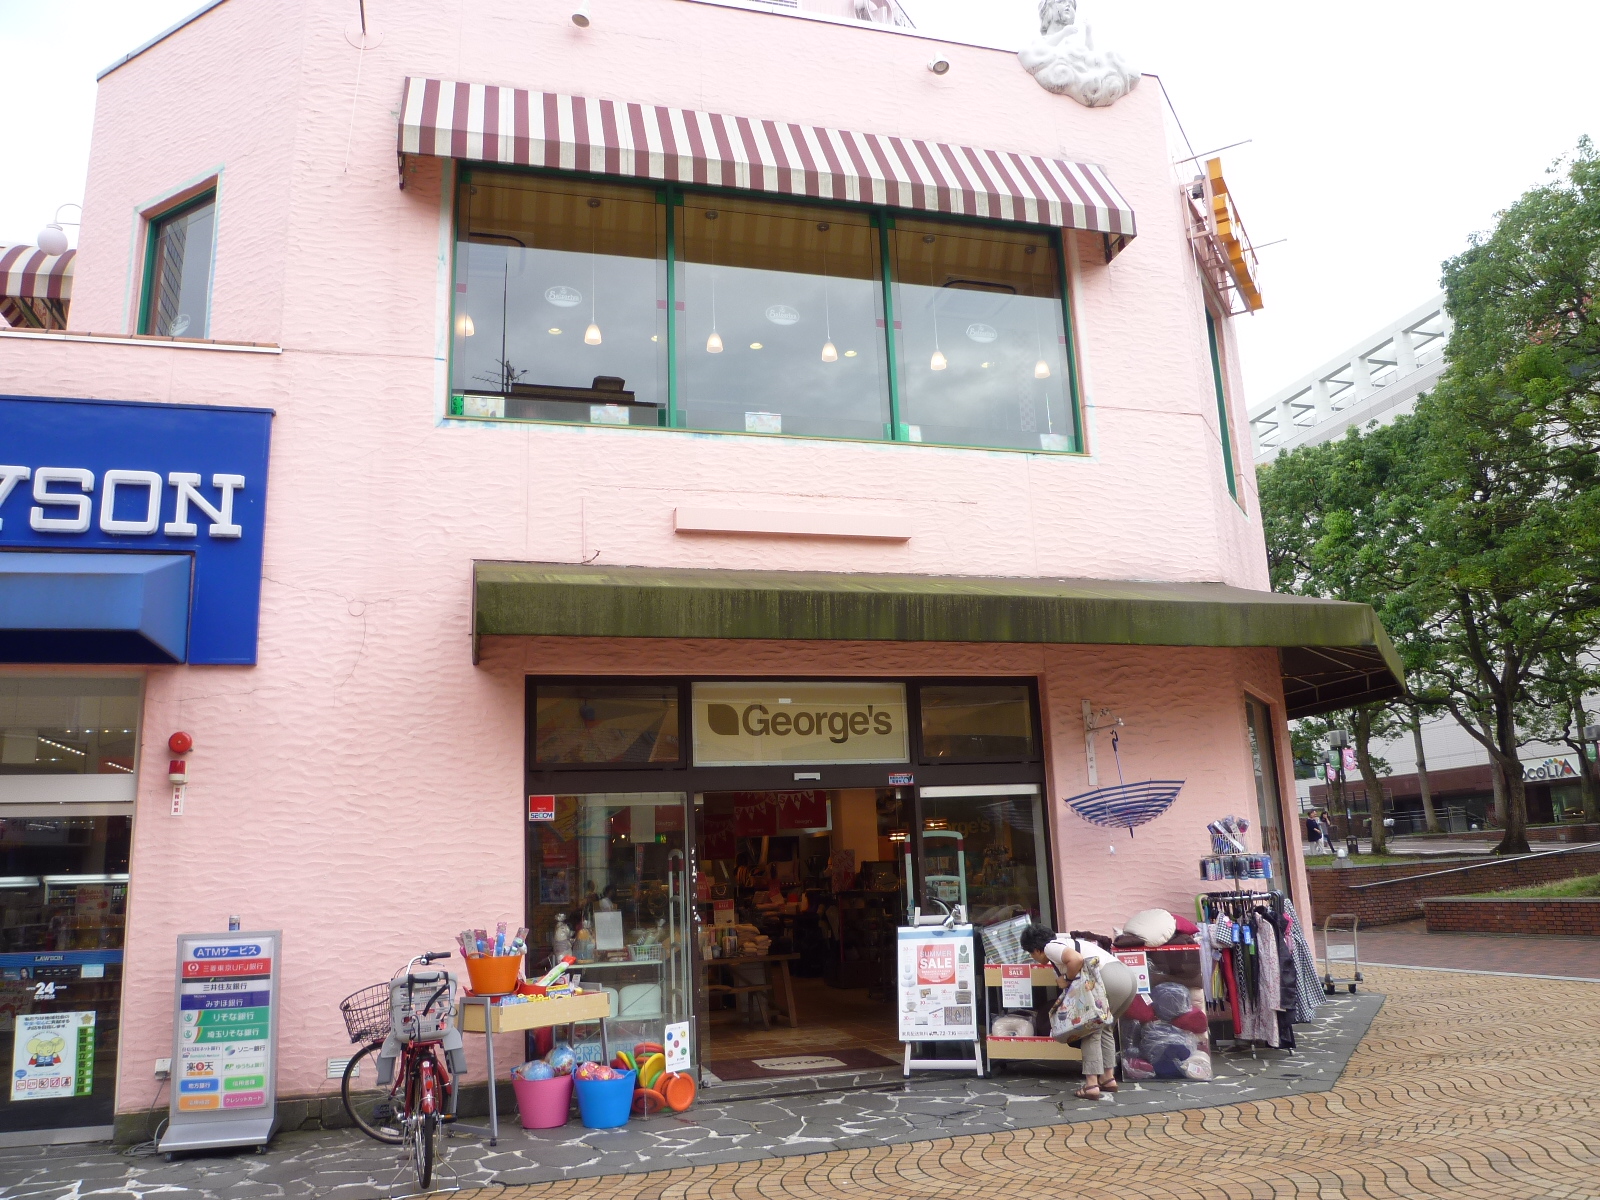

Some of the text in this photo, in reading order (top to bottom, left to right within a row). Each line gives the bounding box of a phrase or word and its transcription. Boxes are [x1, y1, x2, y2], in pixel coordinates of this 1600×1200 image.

[742, 704, 893, 744] George's
[197, 946, 257, 957] ATMサービス
[920, 958, 952, 969] SALE
[35, 982, 55, 995] 24
[203, 982, 247, 991] 三井住友銀行
[206, 999, 243, 1008] みずほ銀行
[213, 1012, 255, 1021] りそな銀行
[207, 1028, 260, 1039] 埼玉りそな銀行
[238, 1045, 266, 1053] ソニー銀行
